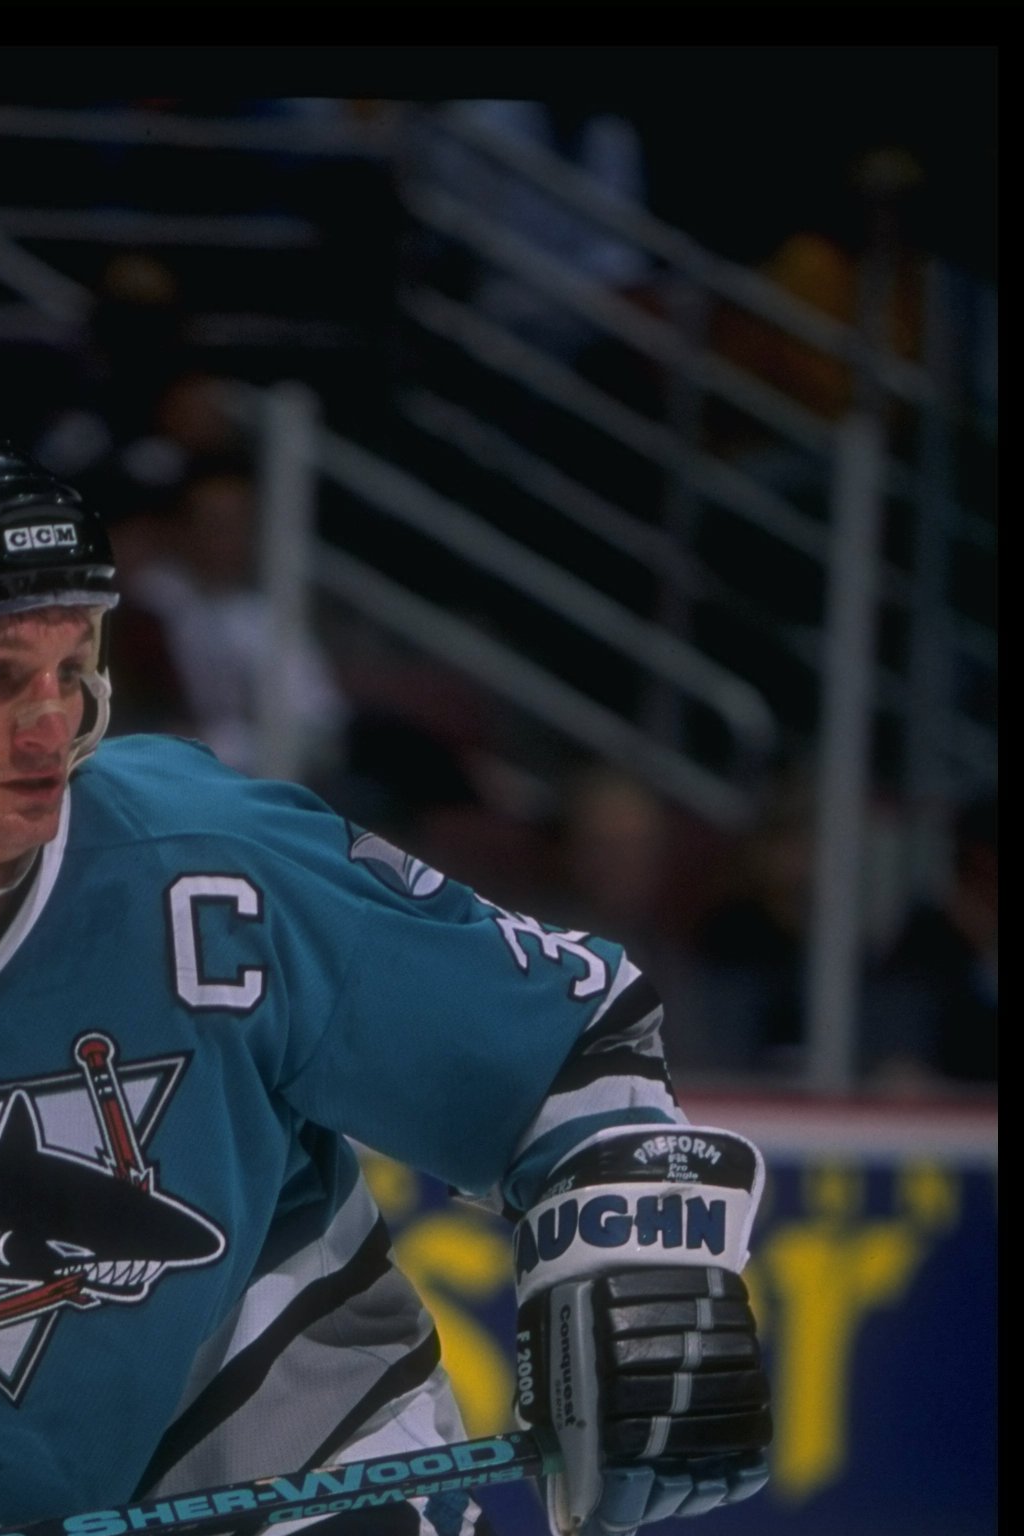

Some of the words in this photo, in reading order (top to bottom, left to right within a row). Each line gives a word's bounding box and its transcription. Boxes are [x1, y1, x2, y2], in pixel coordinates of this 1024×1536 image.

[4, 524, 76, 551] CCM
[165, 873, 264, 1011] C
[633, 1135, 722, 1165] PREFORM
[514, 1195, 726, 1287] AUGHN
[517, 1348, 534, 1405] 2000
[560, 1304, 576, 1427] Conquest
